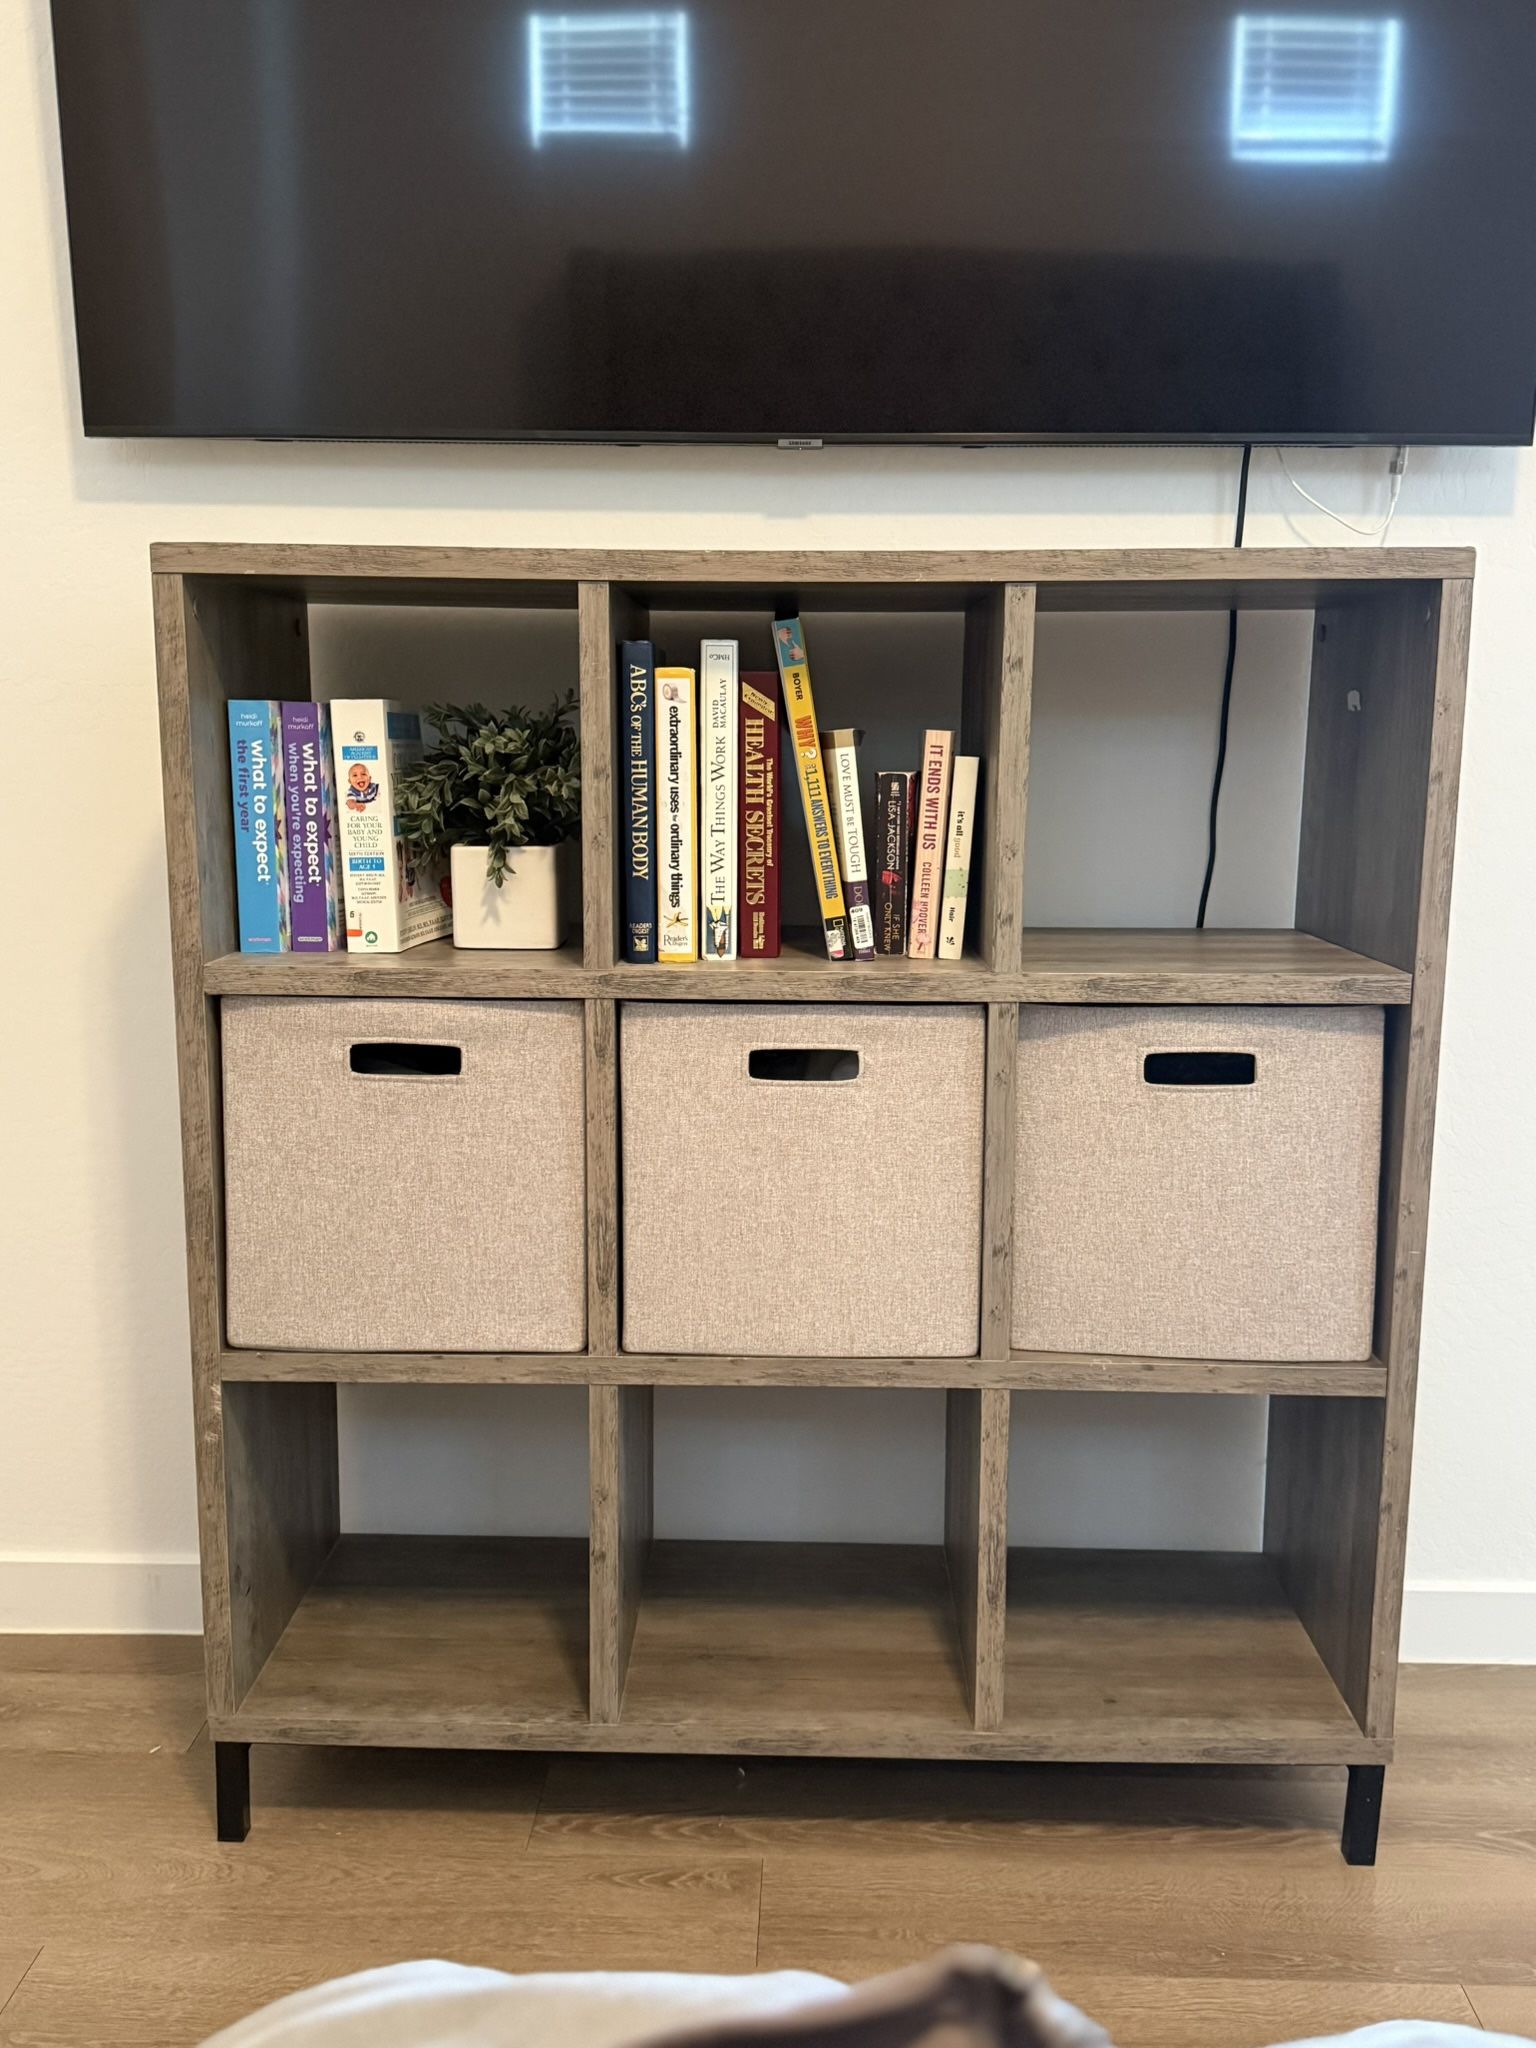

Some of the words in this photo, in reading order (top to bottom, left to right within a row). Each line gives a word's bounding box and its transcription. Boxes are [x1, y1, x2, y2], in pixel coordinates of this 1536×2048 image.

[709, 653, 730, 661] HMCo
[792, 672, 803, 701] BOYER
[719, 678, 727, 728] MACAULAY
[630, 715, 642, 731] OF
[237, 740, 248, 763] the
[631, 731, 642, 757] THE
[668, 705, 682, 785] extraordinary
[710, 736, 726, 782] WORK
[929, 744, 944, 757] IT
[251, 740, 267, 790] what
[288, 742, 300, 782] when
[302, 743, 318, 792] what
[745, 718, 764, 804] HEALTH
[840, 753, 852, 781] LOVE
[926, 759, 943, 794] ENDS
[238, 768, 250, 798] first
[631, 760, 648, 829] HUMAN
[842, 784, 855, 814] MUST
[253, 795, 267, 814] to
[288, 785, 302, 831] you're
[304, 797, 319, 816] to
[669, 786, 679, 813] uses
[710, 784, 725, 837] THINGS
[887, 800, 897, 821] LISA
[923, 797, 940, 830] WITH
[237, 801, 249, 833] year
[811, 798, 829, 842] ANSWERS
[846, 816, 855, 827] BE
[955, 825, 963, 837] all
[956, 811, 966, 824] it's
[252, 819, 271, 882] expect
[303, 821, 322, 884] expect
[631, 831, 649, 880] BODY
[669, 823, 683, 871] ordinary
[710, 840, 725, 874] WAY
[745, 810, 765, 905] SECRETS
[817, 840, 831, 854] TO
[847, 828, 862, 874] TOUGH
[886, 822, 896, 870] JACKSON
[922, 833, 937, 850] US
[953, 837, 962, 858] good
[291, 834, 306, 904] expecting
[819, 850, 838, 899] EVERYTHING
[919, 861, 932, 899] COLLEEN
[669, 872, 683, 908] things
[710, 876, 725, 904] THE
[883, 902, 893, 925] ONLY
[893, 913, 901, 922] IF
[917, 901, 929, 934] HOOVER
[948, 906, 956, 923] Hair
[663, 934, 689, 946] Reader's
[883, 927, 892, 952] KNEW
[892, 923, 901, 940] SHE
